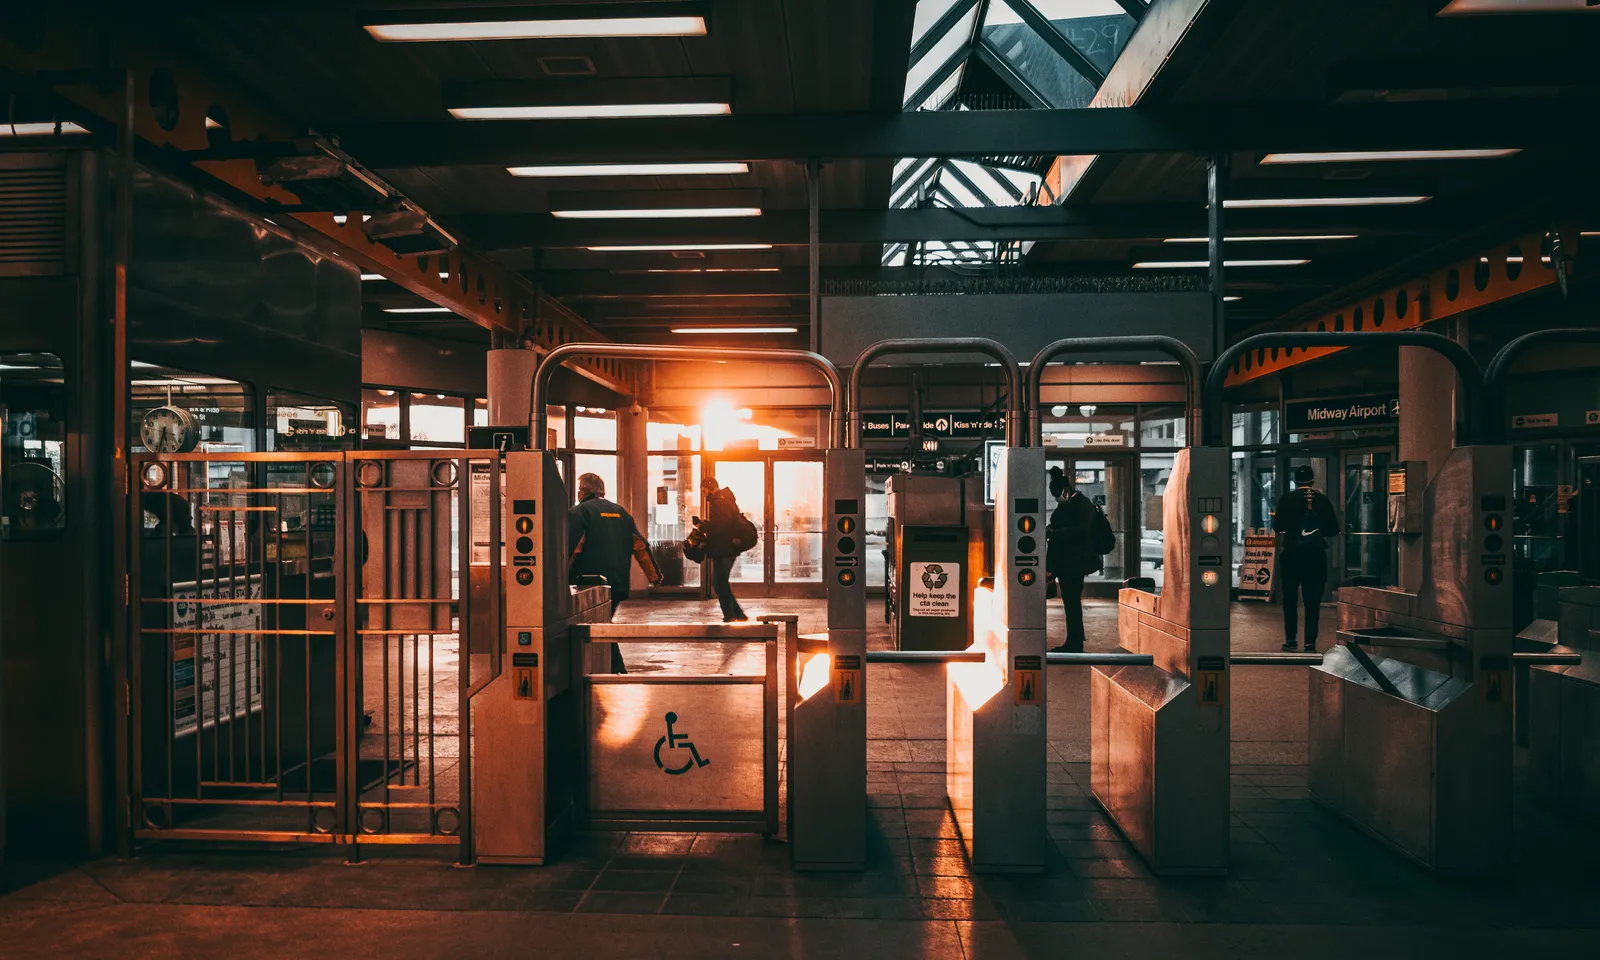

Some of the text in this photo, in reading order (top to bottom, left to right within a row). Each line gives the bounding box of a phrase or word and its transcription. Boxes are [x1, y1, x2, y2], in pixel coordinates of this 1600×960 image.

[1307, 404, 1386, 420] Midway Airport
[1204, 571, 1216, 581] EXIT
